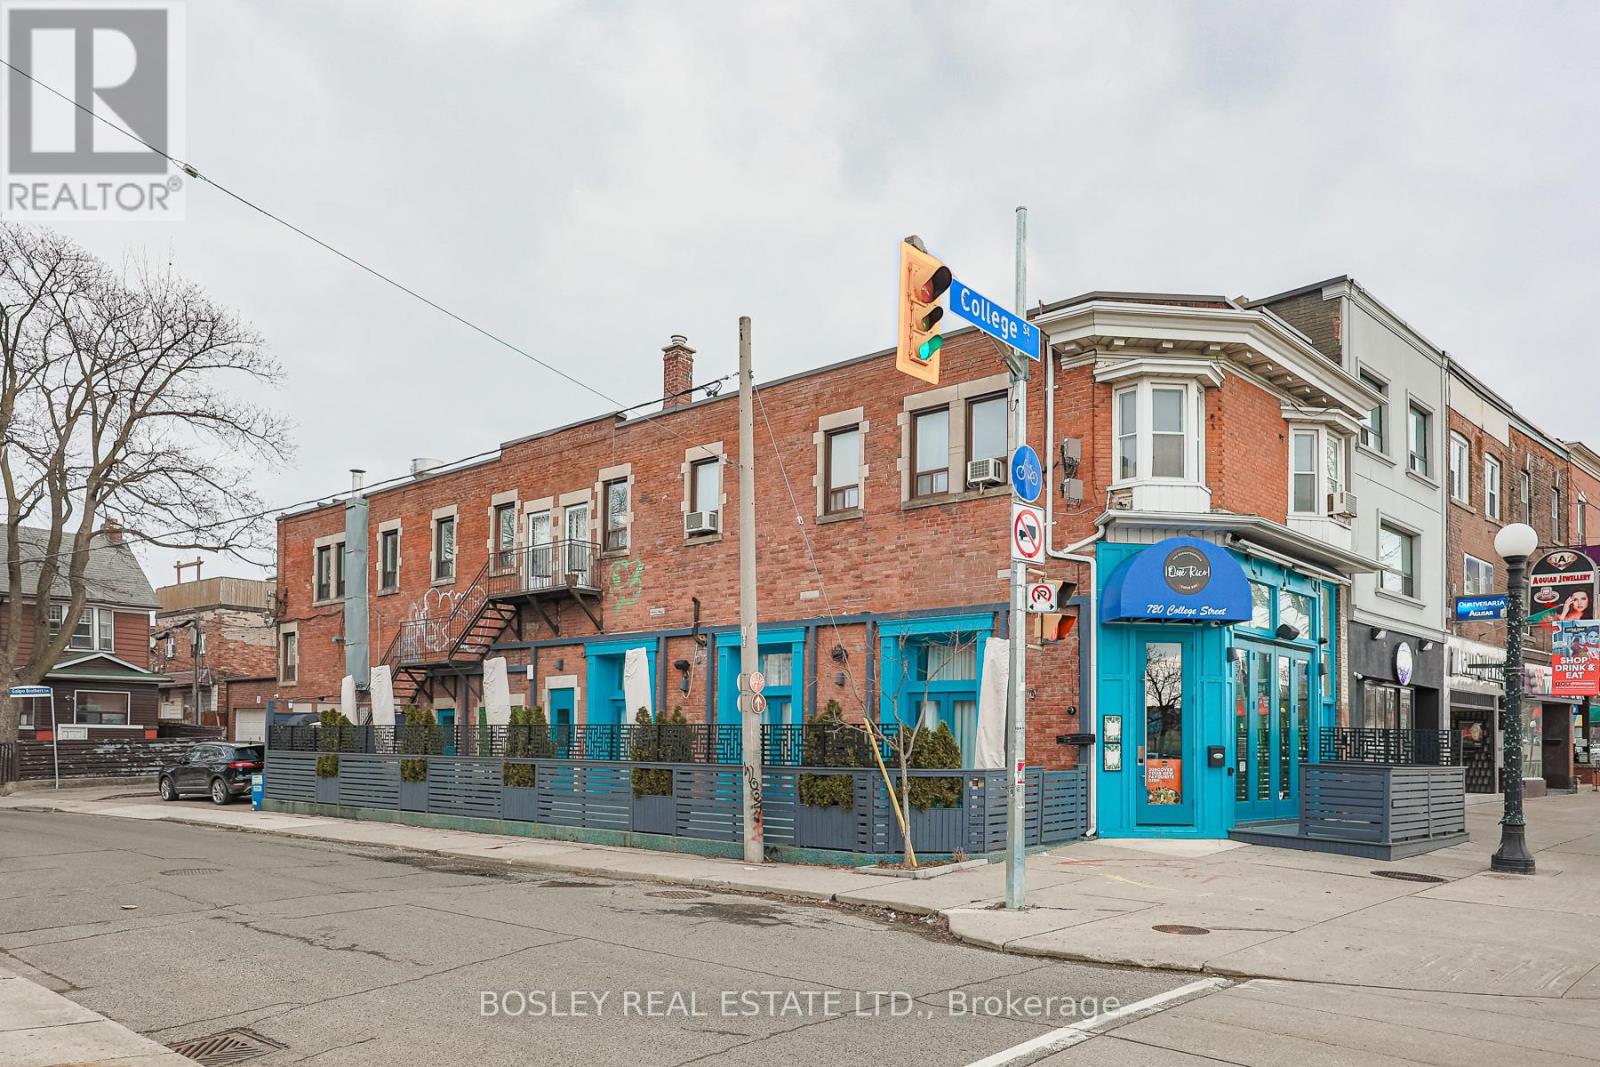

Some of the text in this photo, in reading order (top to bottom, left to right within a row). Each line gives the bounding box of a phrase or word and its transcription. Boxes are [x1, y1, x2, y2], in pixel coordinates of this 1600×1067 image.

[960, 288, 1031, 340] College St
[1558, 574, 1591, 583] JEWELLERY
[1167, 604, 1197, 618] College
[1199, 605, 1227, 616] Street
[1555, 662, 1596, 671] DRINK &
[1565, 671, 1584, 679] EAT
